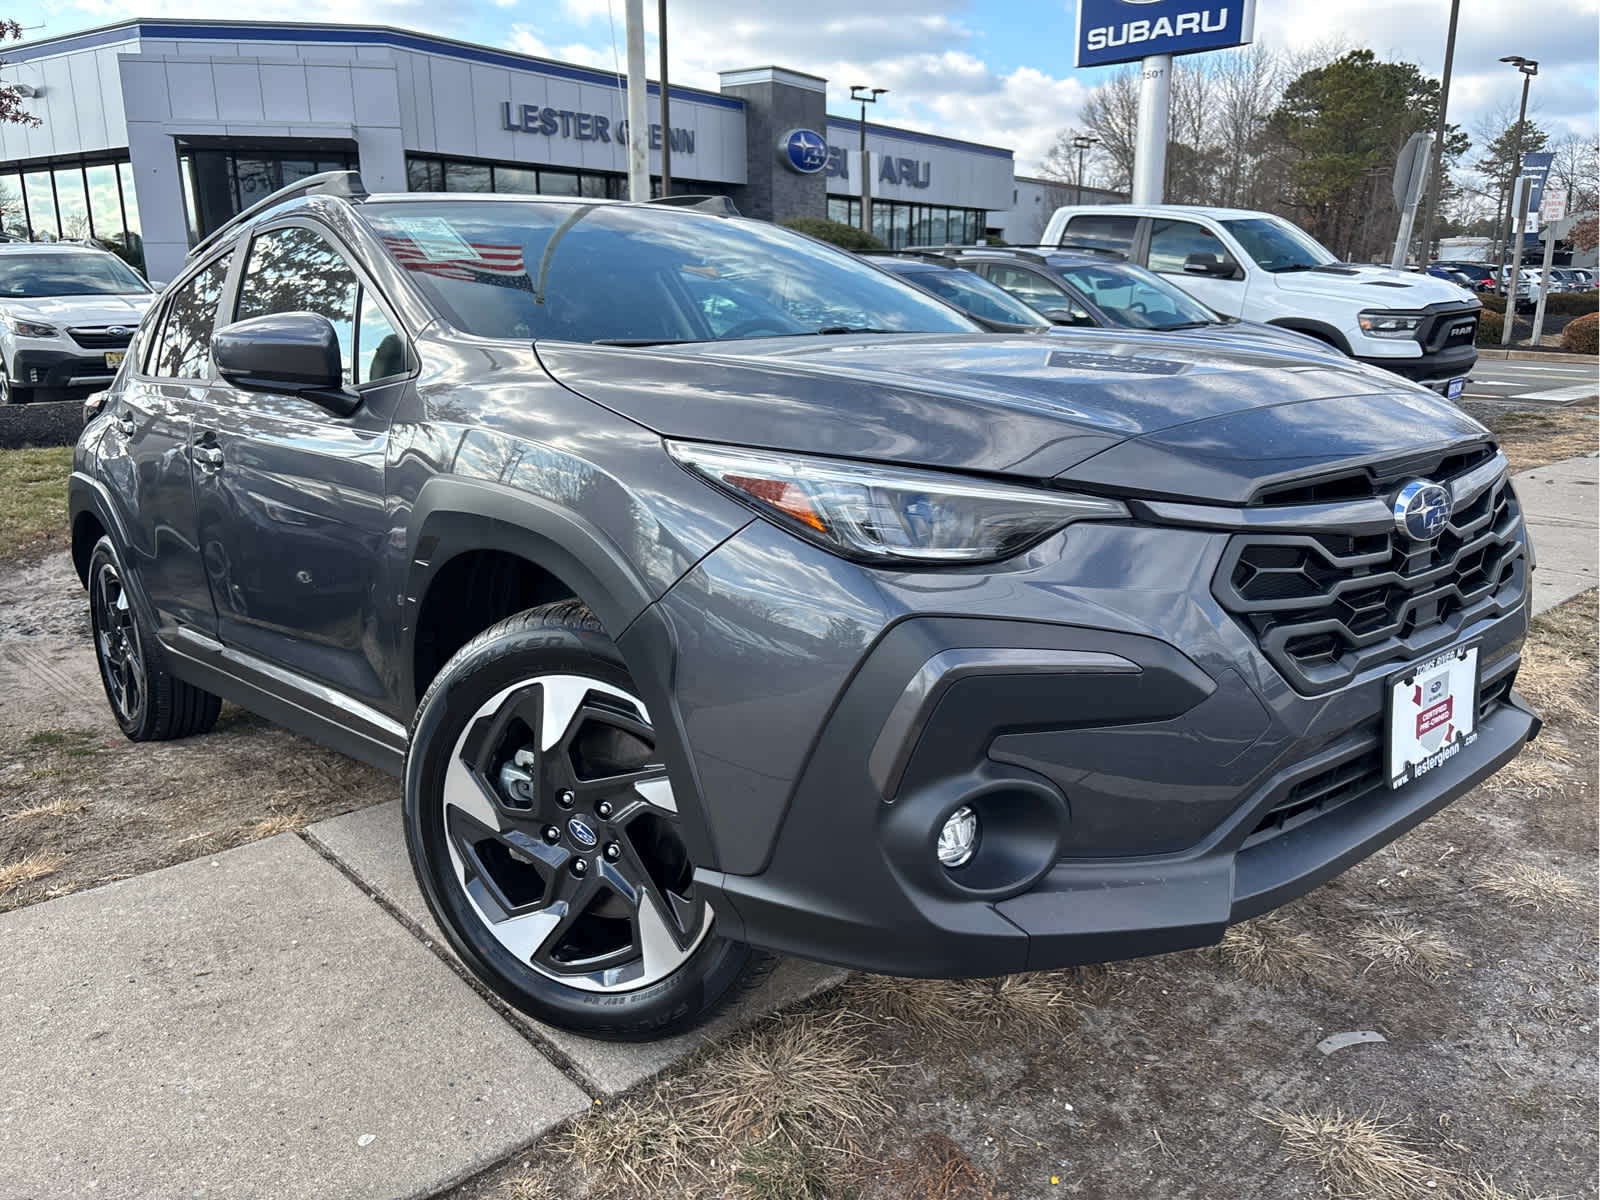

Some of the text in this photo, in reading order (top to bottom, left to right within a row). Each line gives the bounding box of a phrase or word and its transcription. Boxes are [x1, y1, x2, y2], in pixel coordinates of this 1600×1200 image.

[1087, 8, 1228, 51] SUBARU
[503, 101, 695, 153] LESTER GENN
[825, 146, 931, 189] SUARU
[1450, 326, 1473, 337] RAM
[1414, 743, 1460, 778] lesterglenn
